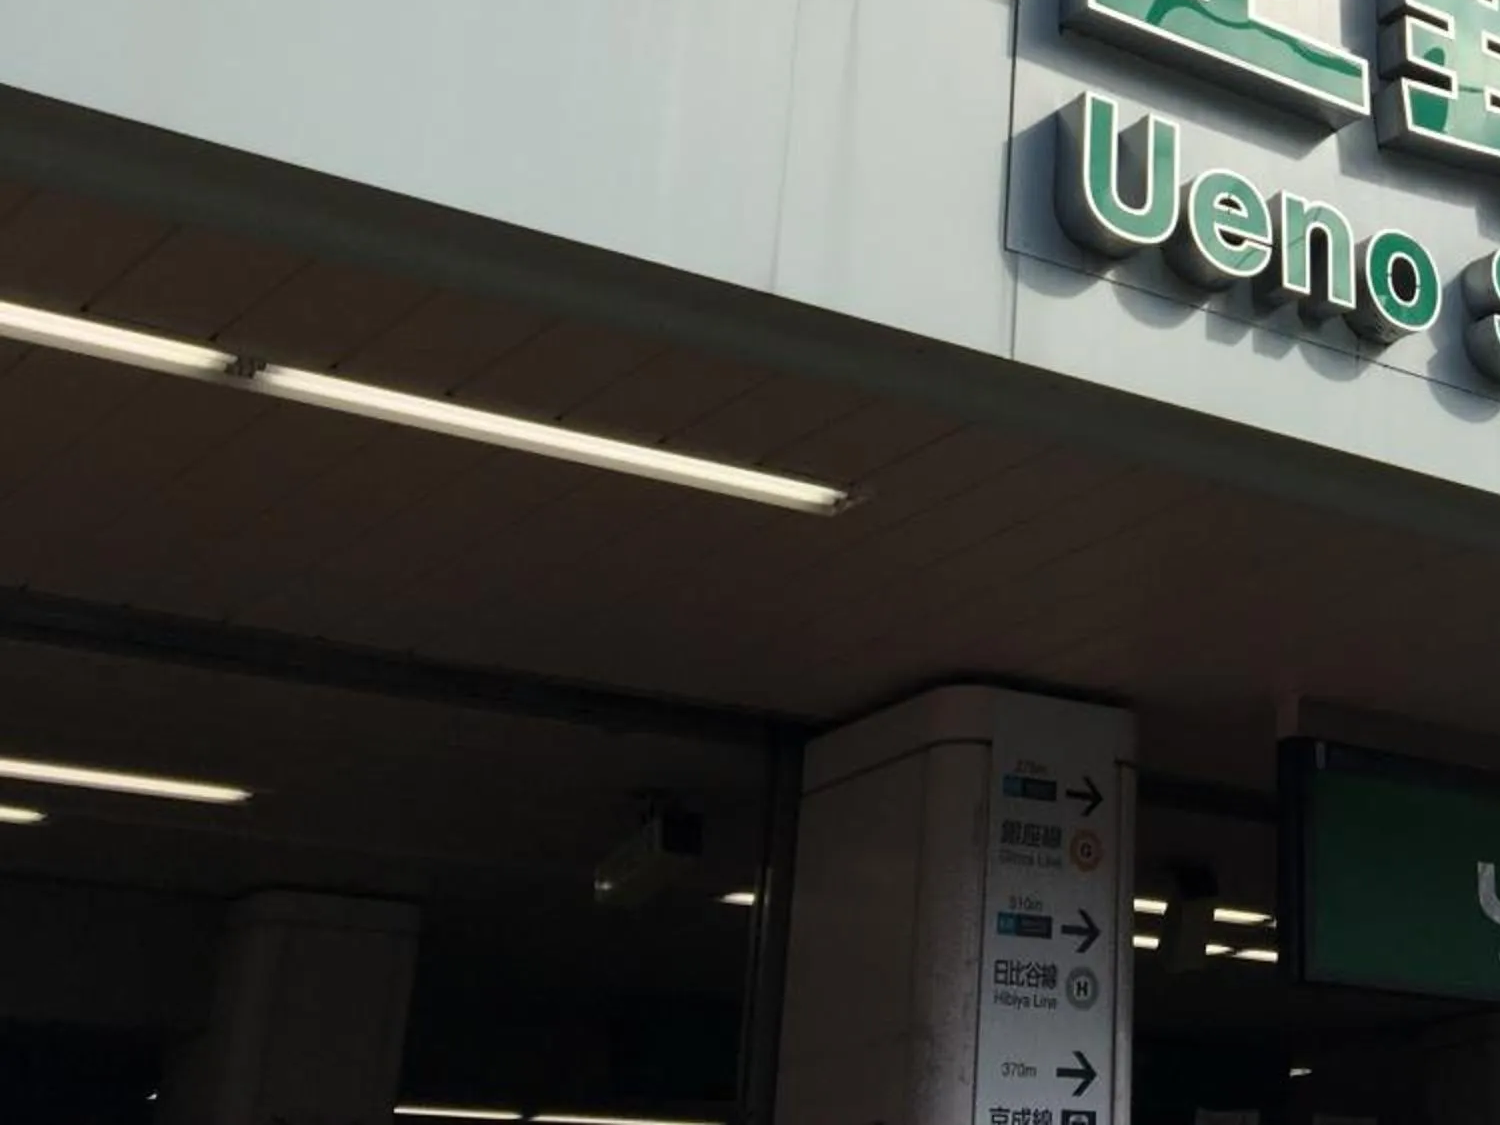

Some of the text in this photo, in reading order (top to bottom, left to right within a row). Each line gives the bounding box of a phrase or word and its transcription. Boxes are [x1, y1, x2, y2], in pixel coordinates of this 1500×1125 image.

[1083, 91, 1442, 333] Ueno
[994, 959, 1057, 989] 日比谷線
[1001, 1061, 1037, 1078] 370m
